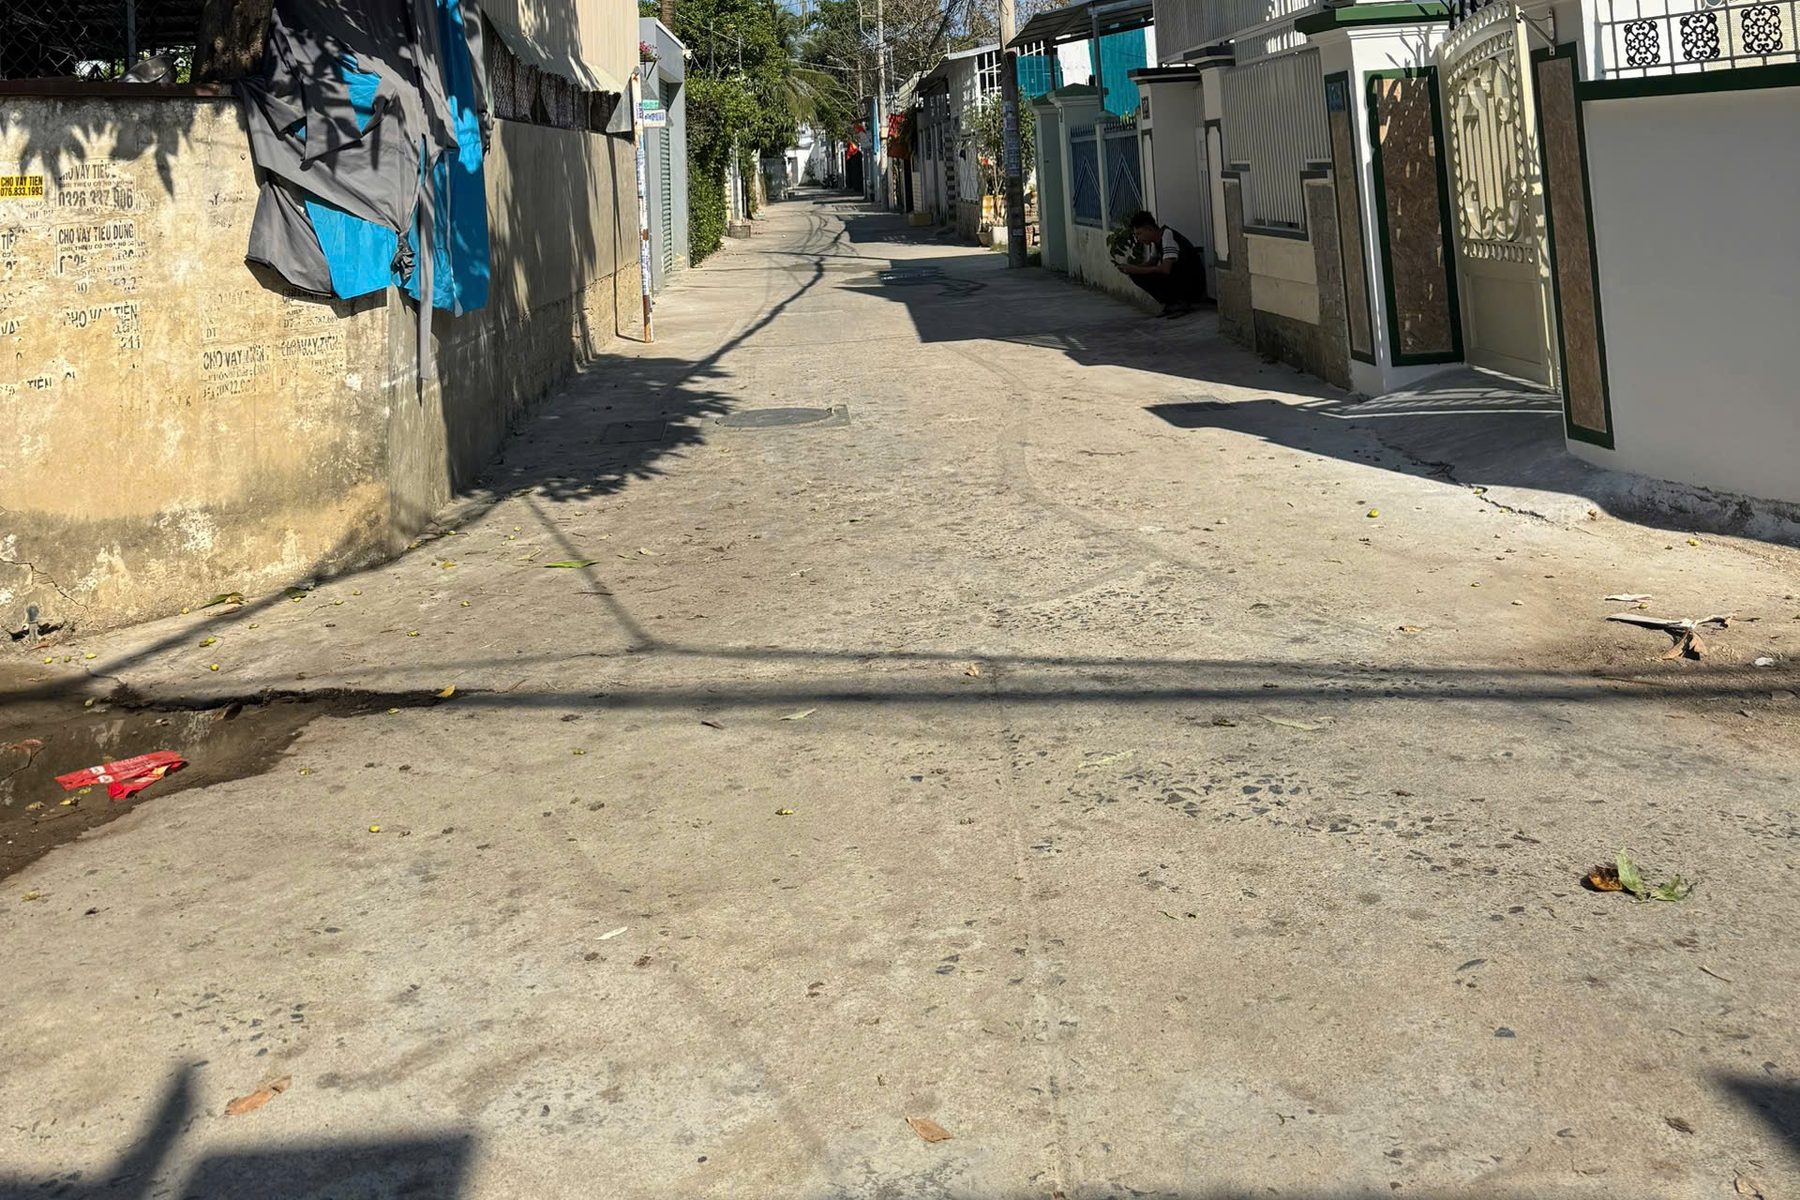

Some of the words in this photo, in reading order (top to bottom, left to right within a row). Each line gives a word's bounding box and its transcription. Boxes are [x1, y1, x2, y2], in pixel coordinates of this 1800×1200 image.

[75, 164, 90, 179] VAY
[0, 176, 14, 187] CHO
[15, 176, 27, 187] VAY
[0, 186, 43, 197] 076.833.1993
[59, 228, 75, 244] CHO
[76, 226, 92, 243] VAY
[225, 350, 242, 367] VAY
